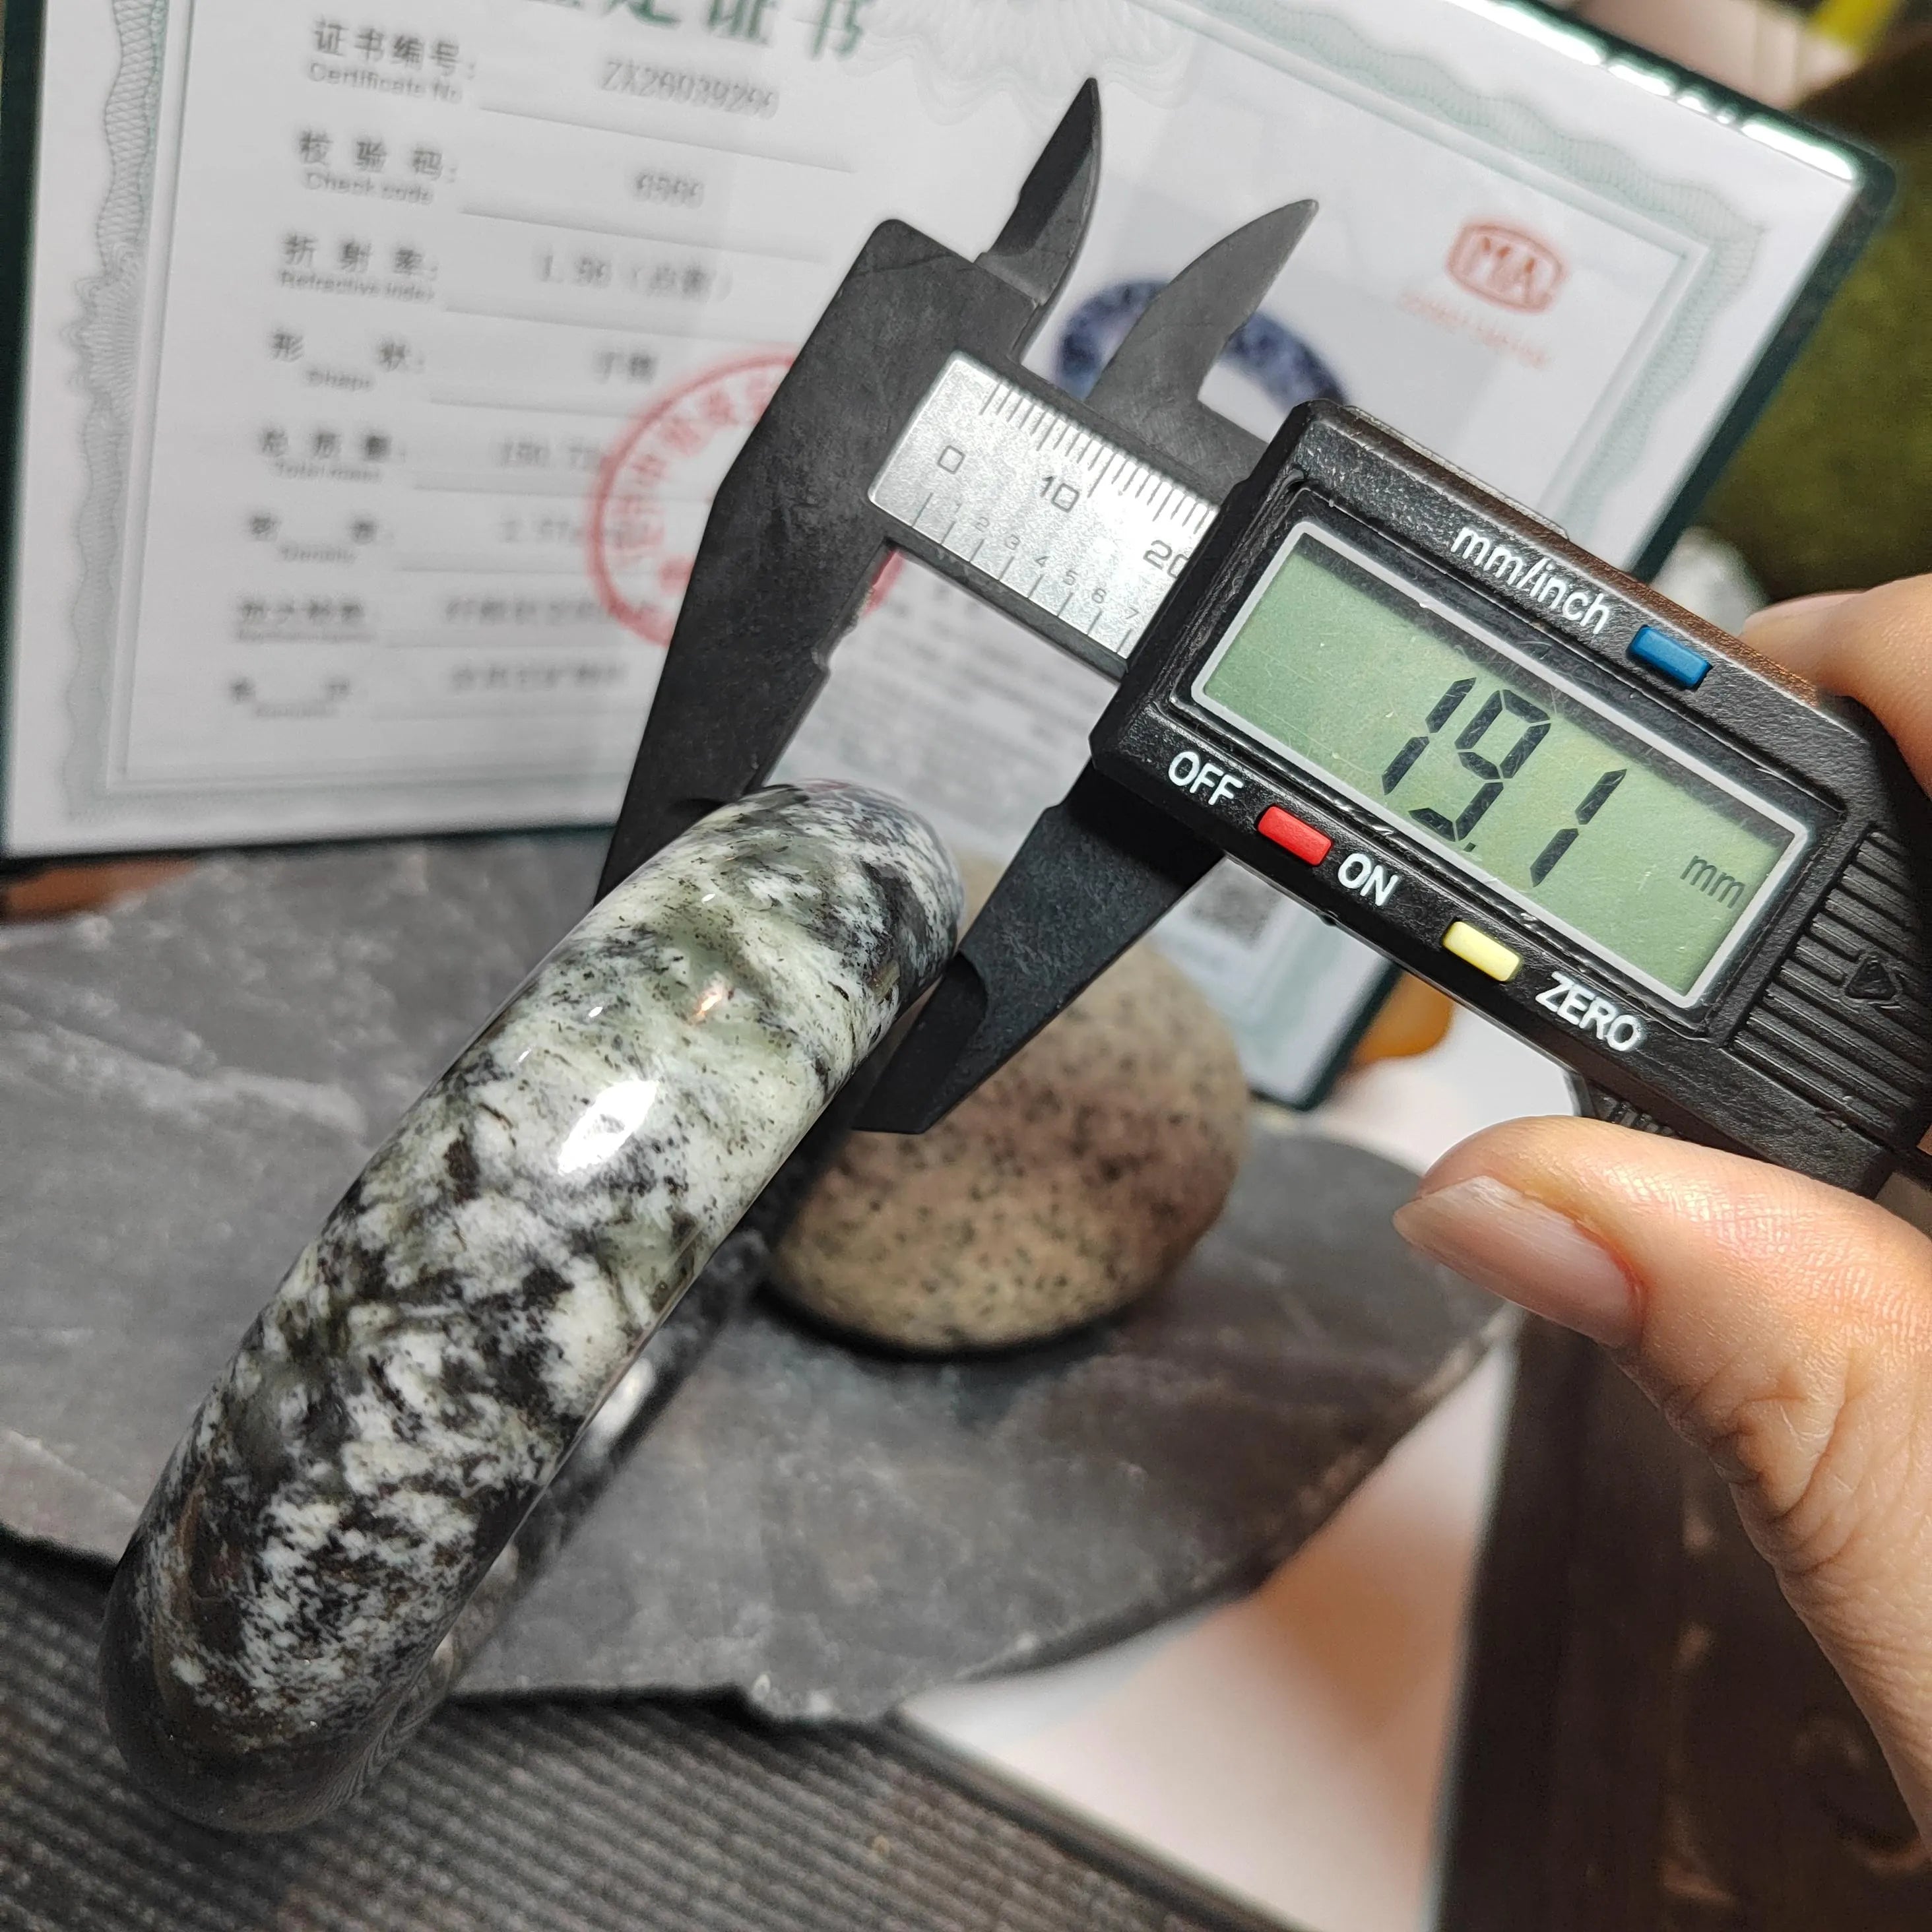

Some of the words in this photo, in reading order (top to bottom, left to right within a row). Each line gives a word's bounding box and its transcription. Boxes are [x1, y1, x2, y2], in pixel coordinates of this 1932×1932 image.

[937, 445, 966, 475] 0
[1039, 476, 1080, 513] 10
[1004, 534, 1021, 551] 3
[1062, 569, 1078, 587] 5
[1450, 527, 1610, 635] mm/inch
[1167, 750, 1244, 806] OFF
[1381, 677, 1627, 888] 19.1
[1679, 855, 1745, 909] mm
[1337, 853, 1400, 907] ON
[1535, 970, 1644, 1052] ZERO
